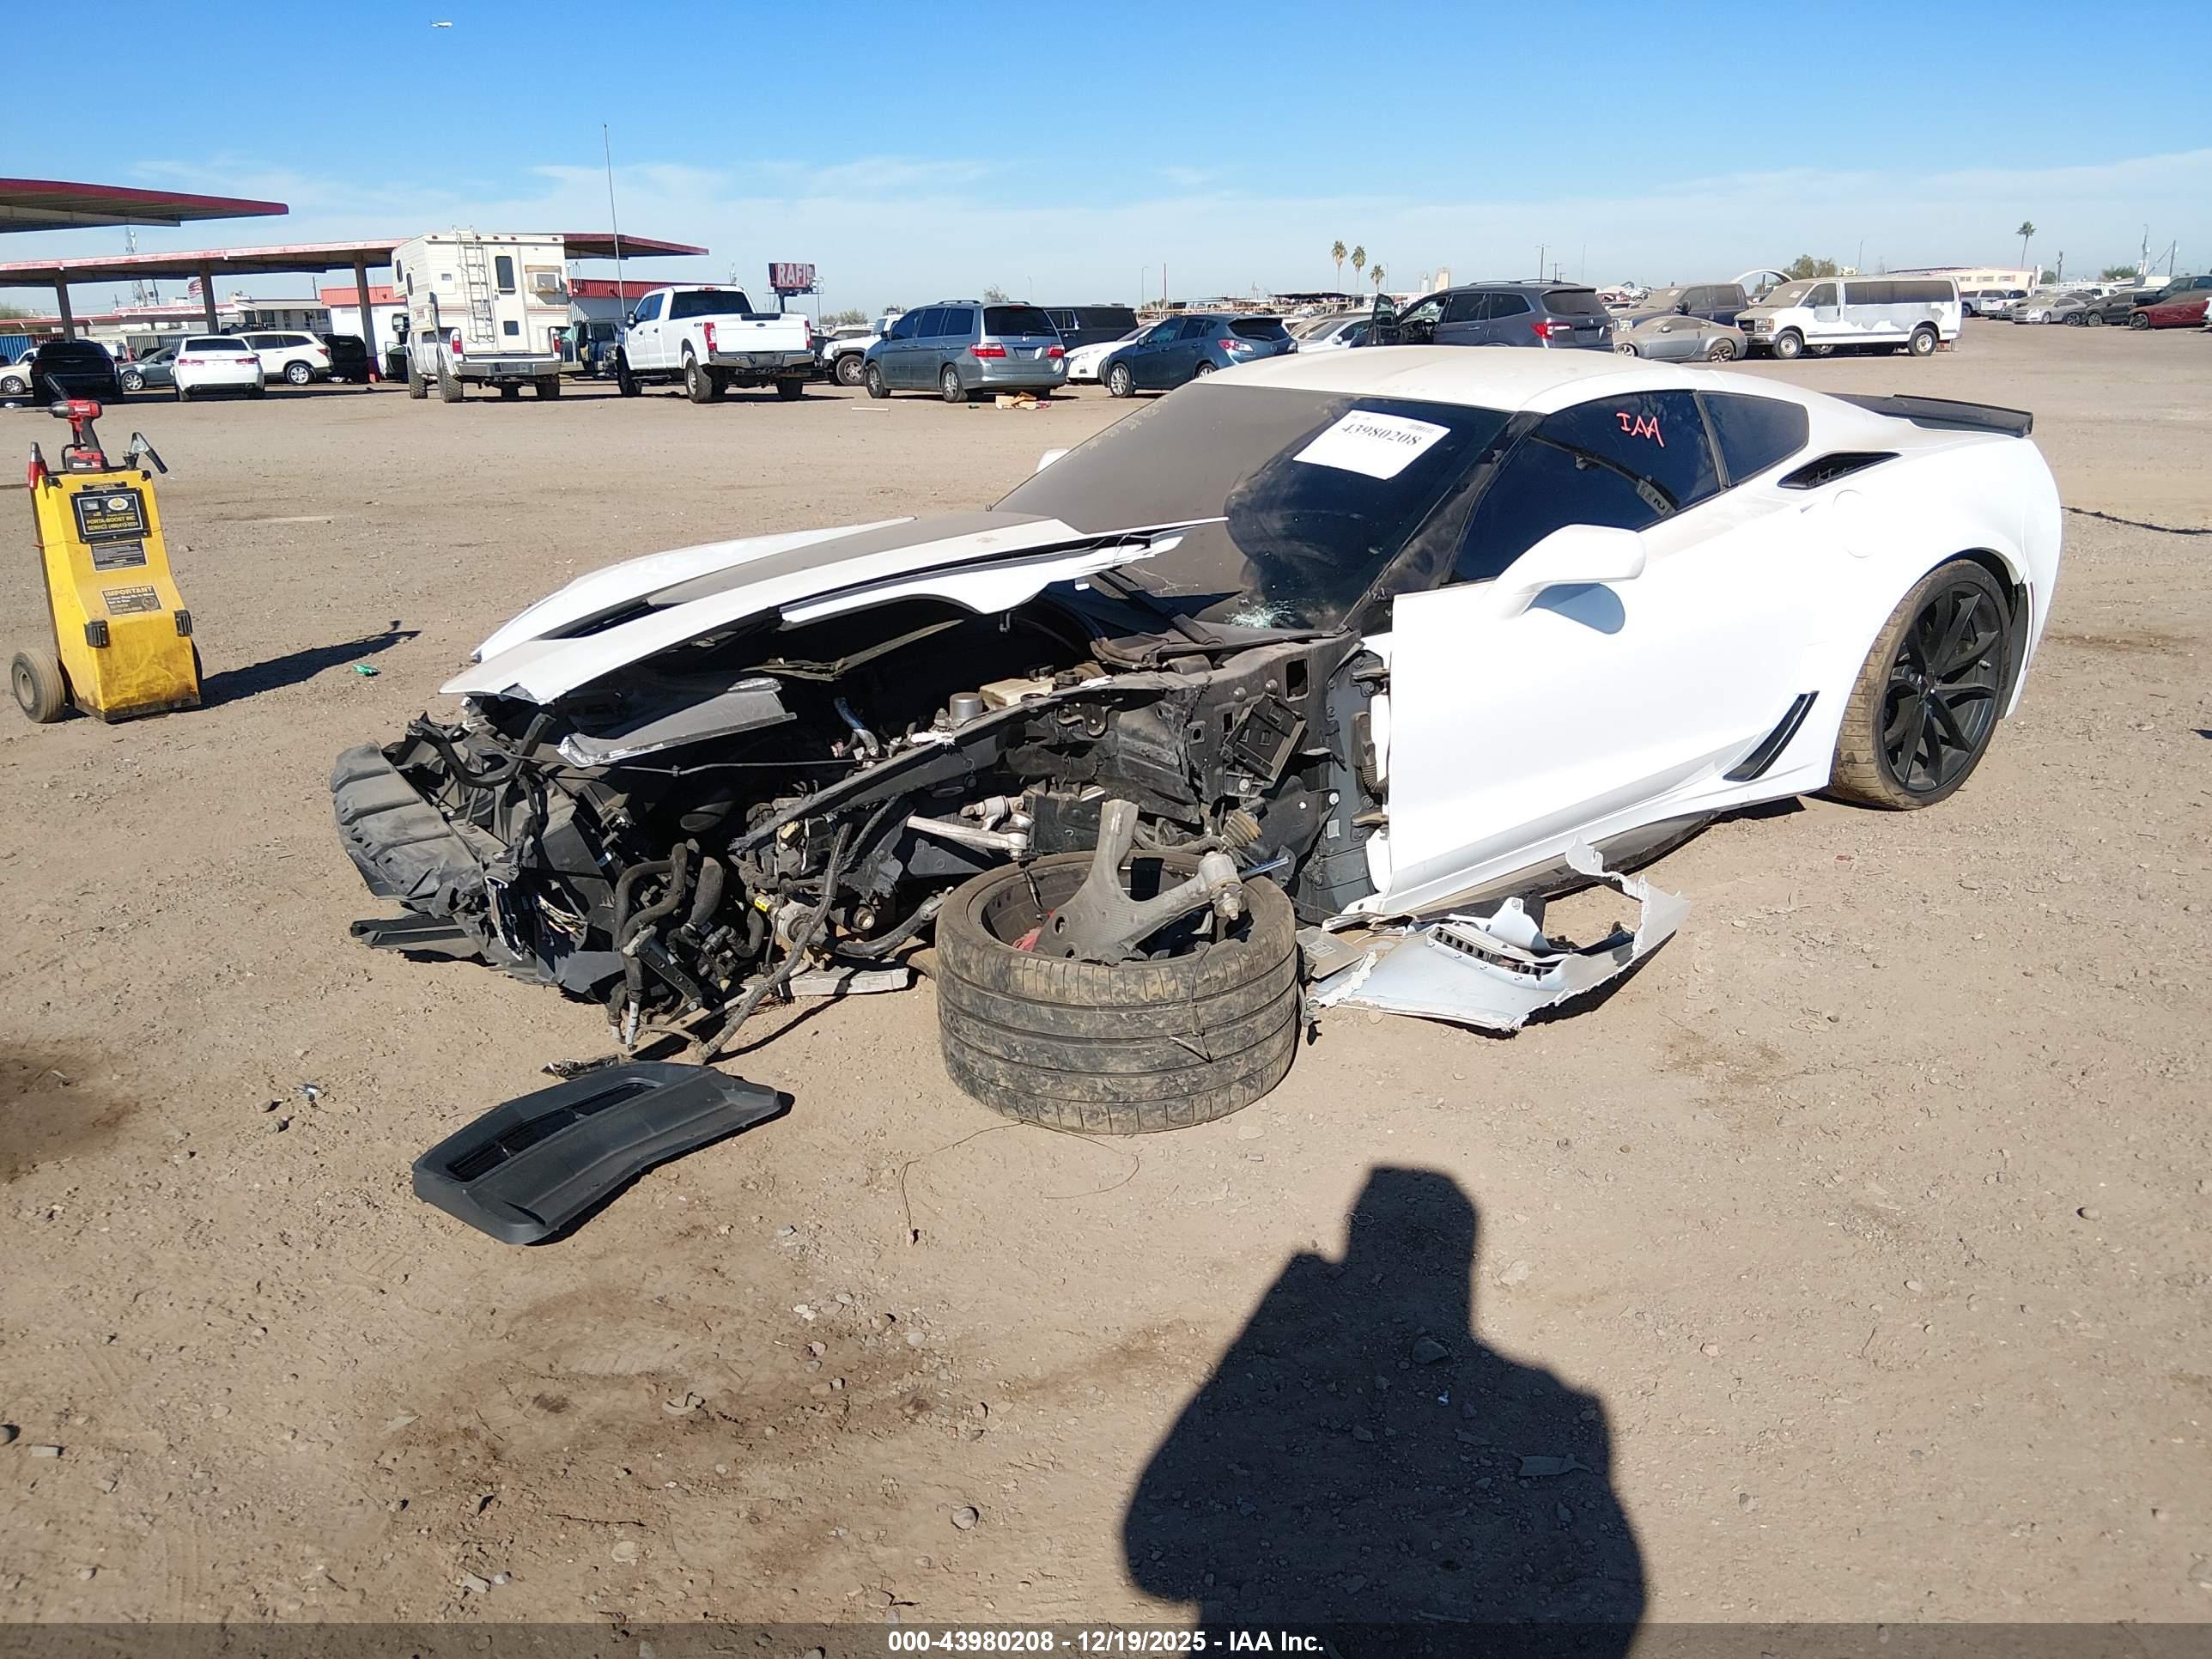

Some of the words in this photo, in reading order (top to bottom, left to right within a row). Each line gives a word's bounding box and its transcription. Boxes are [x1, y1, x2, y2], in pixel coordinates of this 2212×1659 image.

[777, 263, 806, 285] RAFI
[1341, 423, 1422, 446] 43980208
[1616, 412, 1665, 447] IAA
[87, 516, 125, 525] PORTA-BOOST
[104, 586, 153, 597] IMPORTANT
